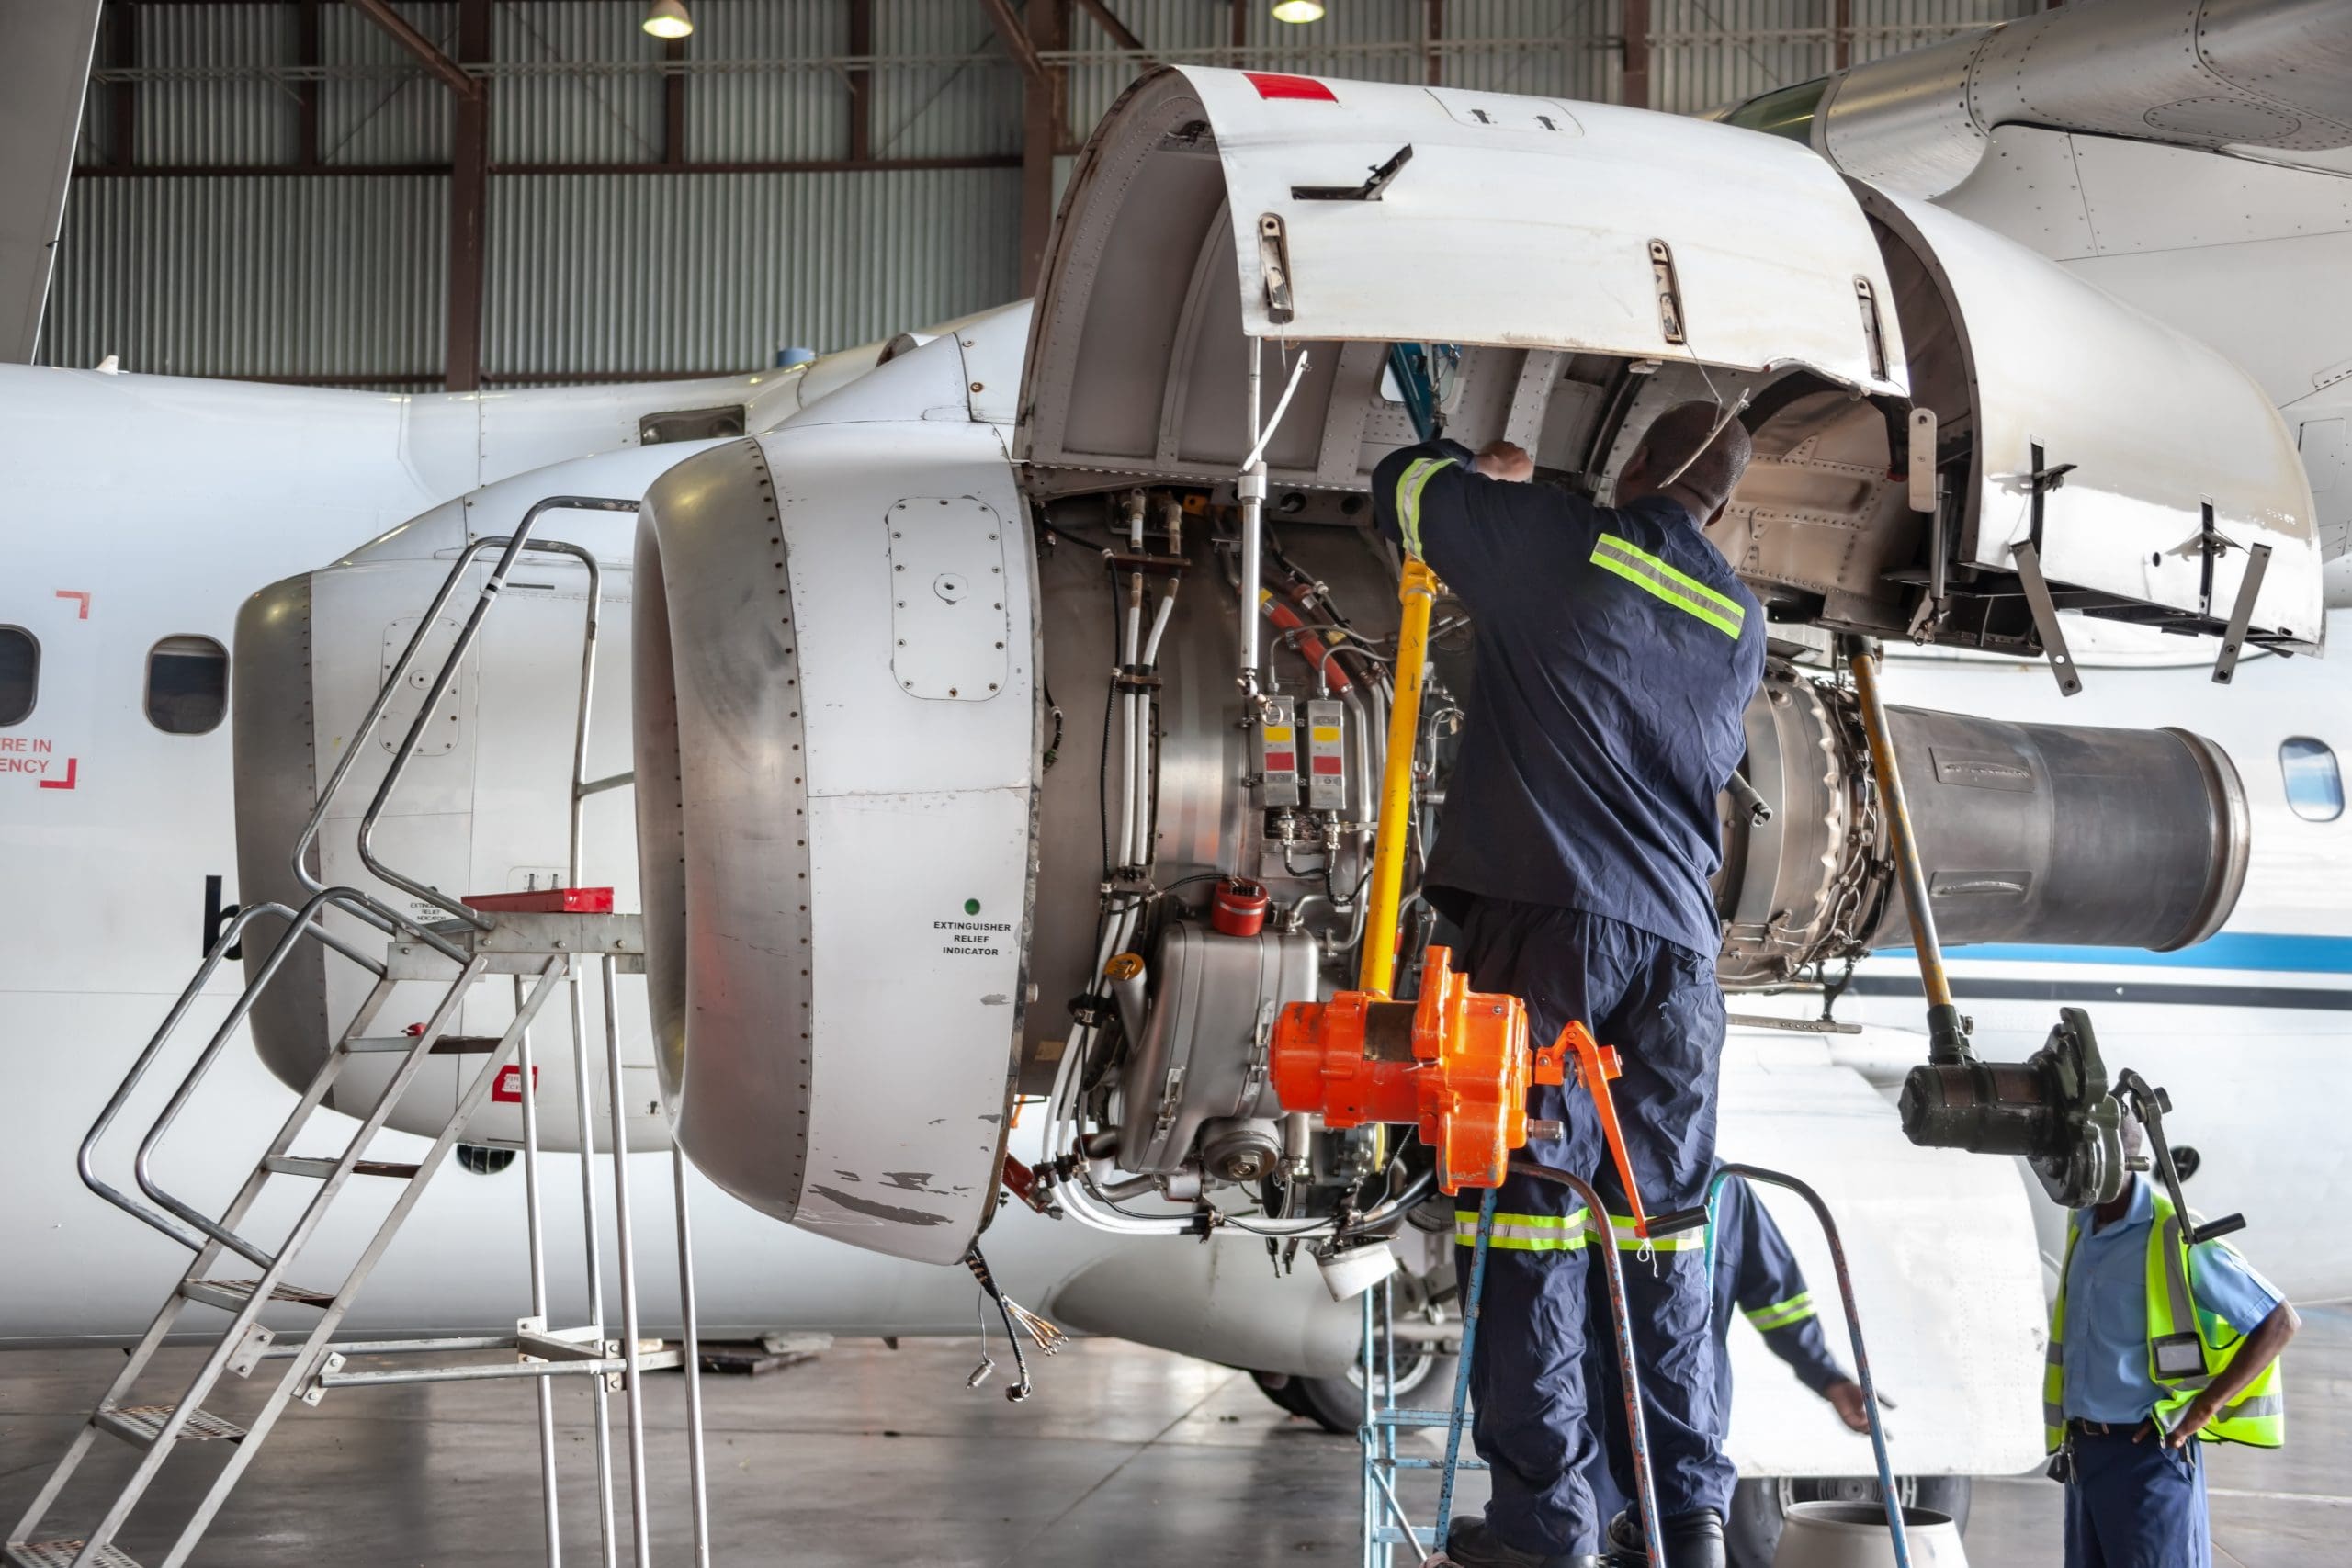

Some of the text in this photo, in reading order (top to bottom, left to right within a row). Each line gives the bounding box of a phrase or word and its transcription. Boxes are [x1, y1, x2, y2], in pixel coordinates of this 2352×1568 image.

[0, 738, 51, 753] RE IN
[933, 921, 1012, 931] EXTINGUISHER
[954, 934, 989, 943] RELIEF
[943, 946, 999, 956] INDICATOR
